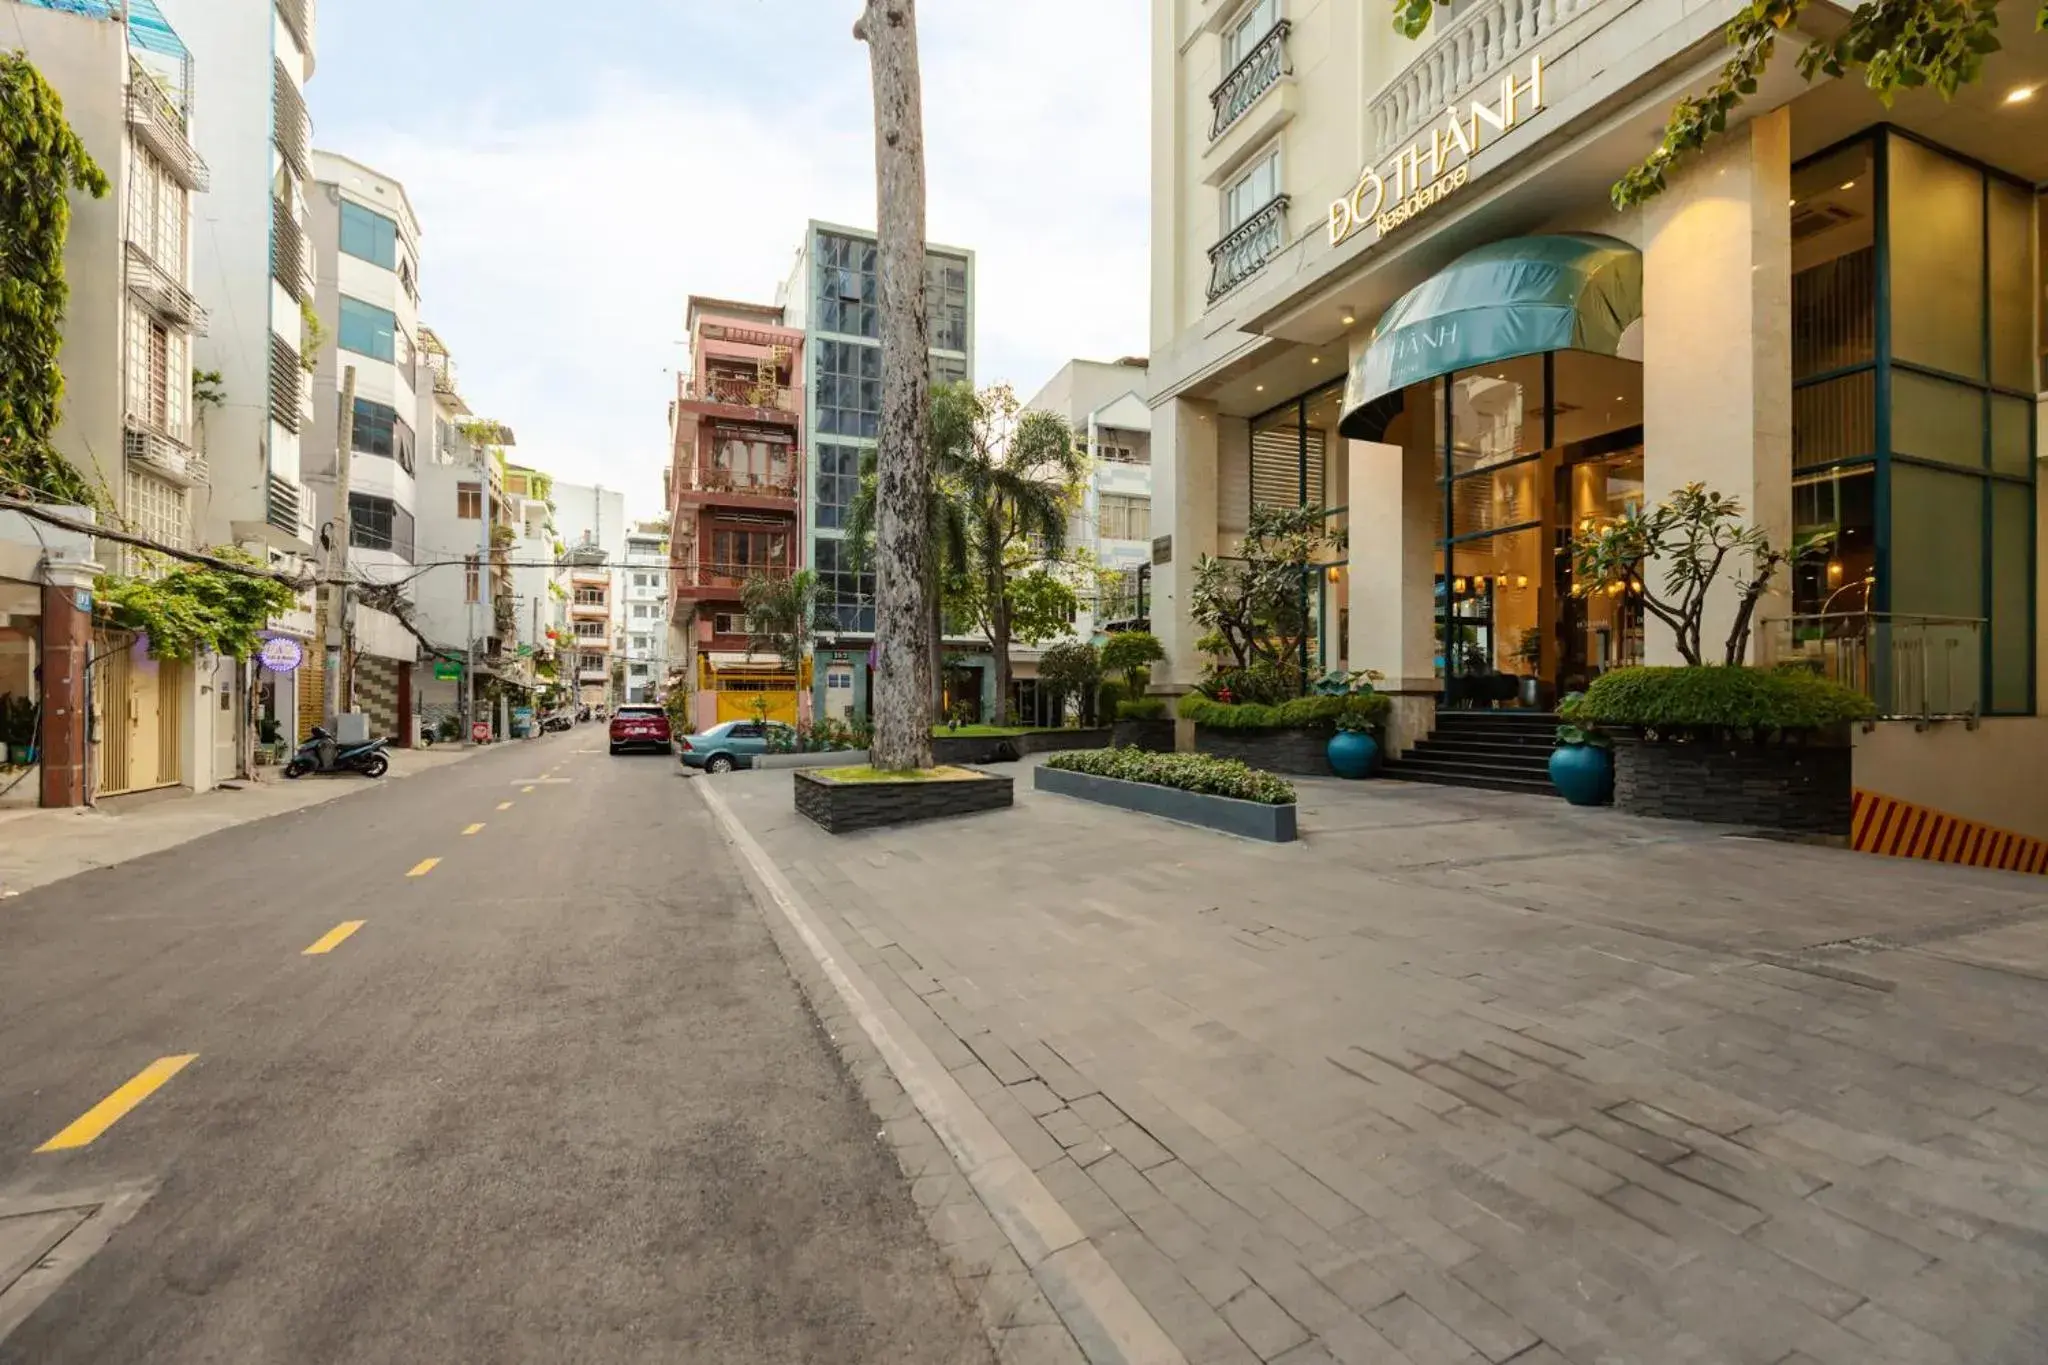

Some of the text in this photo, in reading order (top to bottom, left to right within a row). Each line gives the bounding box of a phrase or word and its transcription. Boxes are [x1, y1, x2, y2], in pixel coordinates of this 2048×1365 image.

[1328, 54, 1545, 246] ĐÔ THÀNH
[1375, 164, 1468, 237] Residence
